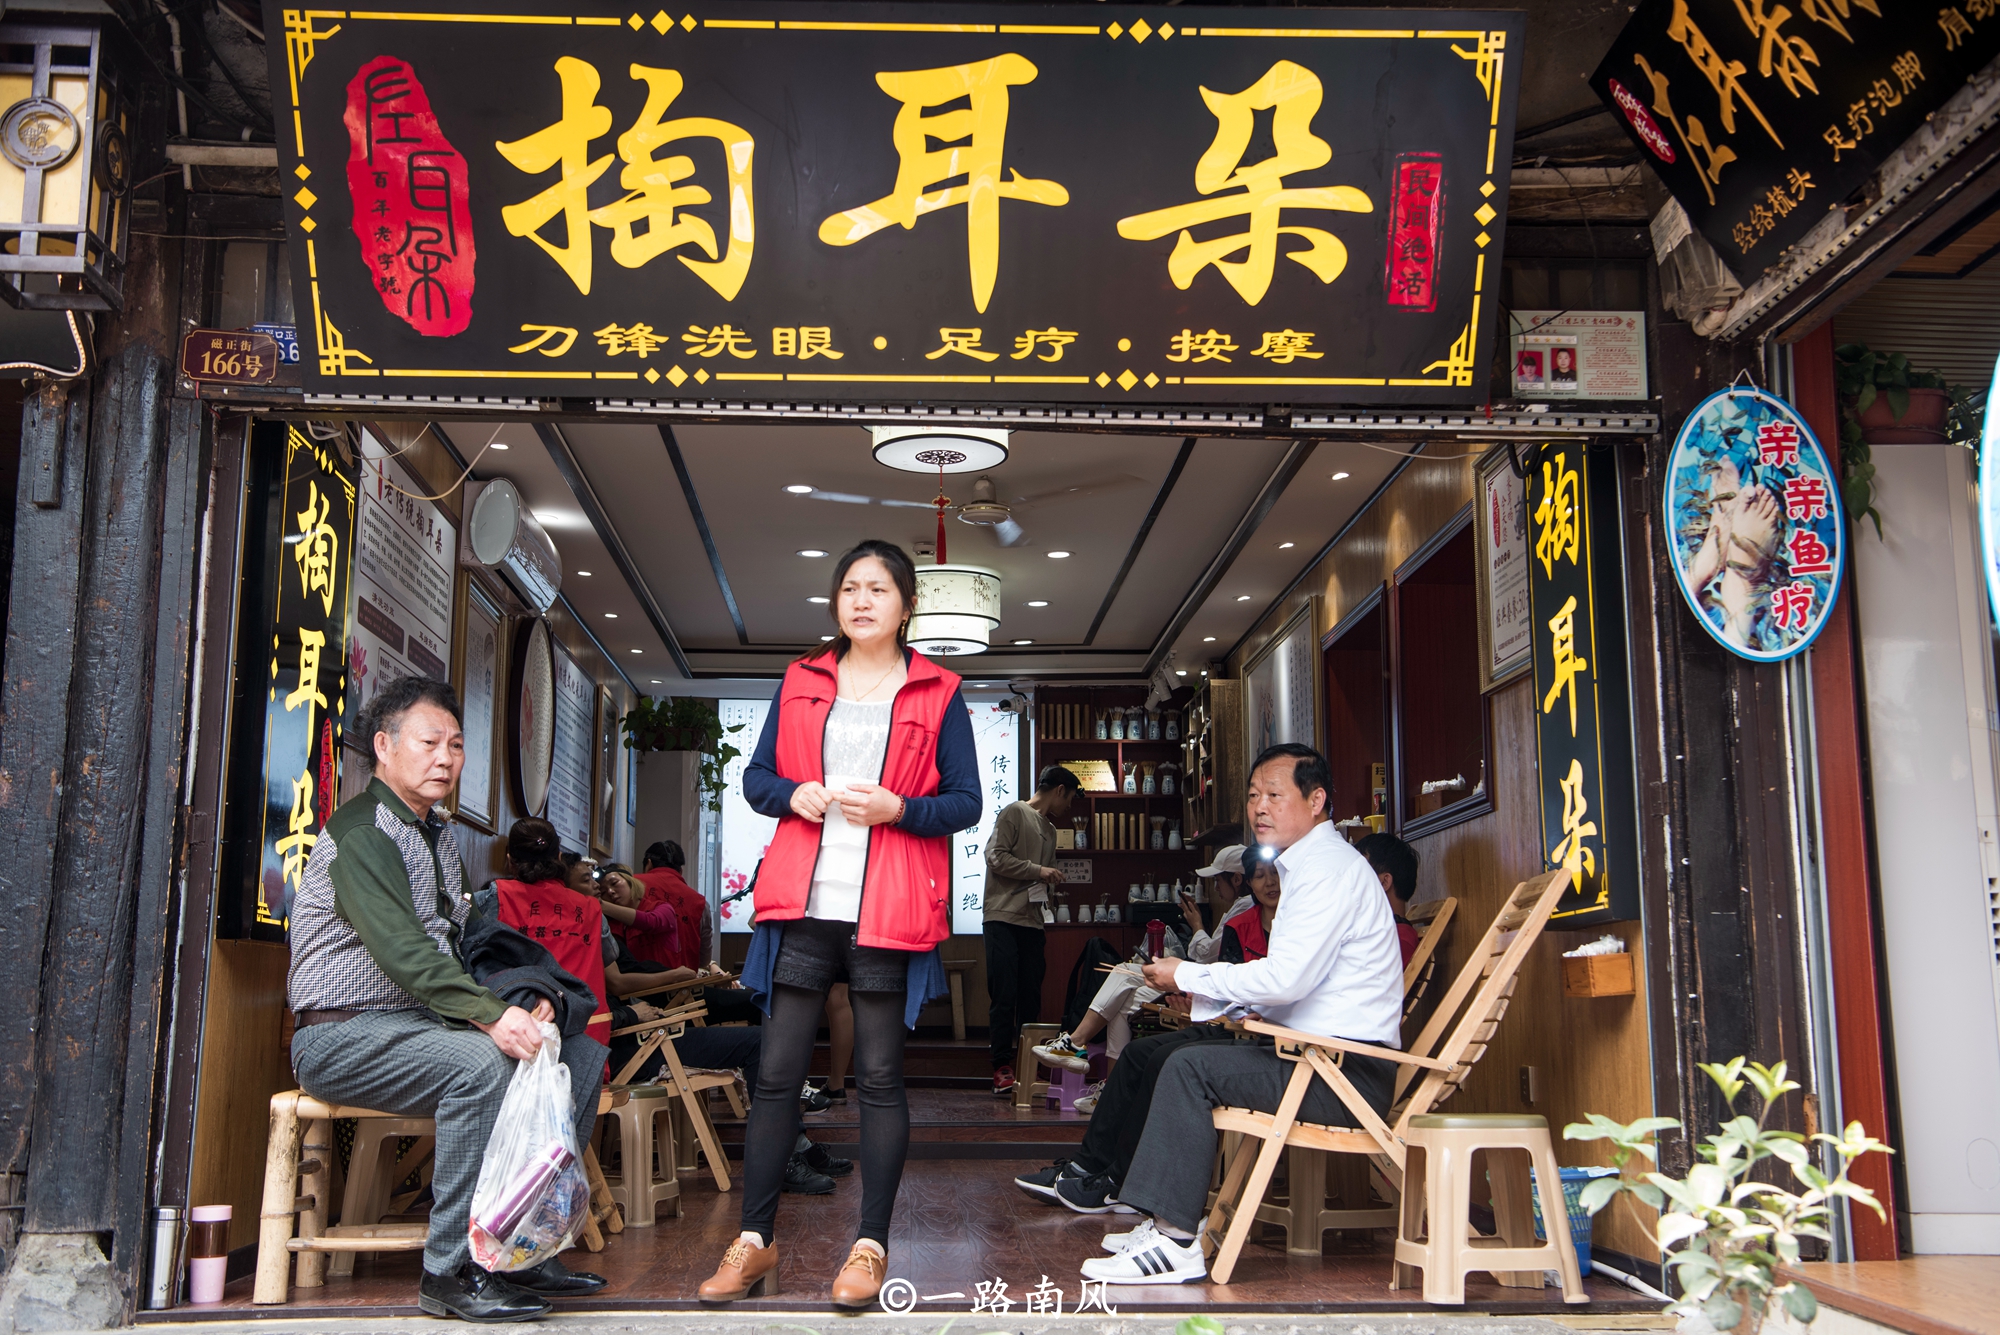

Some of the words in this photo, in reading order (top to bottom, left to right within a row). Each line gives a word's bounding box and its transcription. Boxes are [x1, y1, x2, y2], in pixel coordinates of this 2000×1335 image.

[371, 171, 402, 294] 百年老字號
[495, 53, 1374, 314] 掏耳朵
[1398, 169, 1434, 296] 民间绝活
[1732, 167, 1817, 254] 经络梳头
[1823, 50, 1926, 163] 足疗泡脚
[200, 350, 263, 378] 166号
[211, 338, 252, 352] 磁正街
[1758, 420, 1832, 630] 亲亲鱼疗
[275, 480, 338, 893] 掏耳朵
[1534, 452, 1598, 895] 掏耳朵
